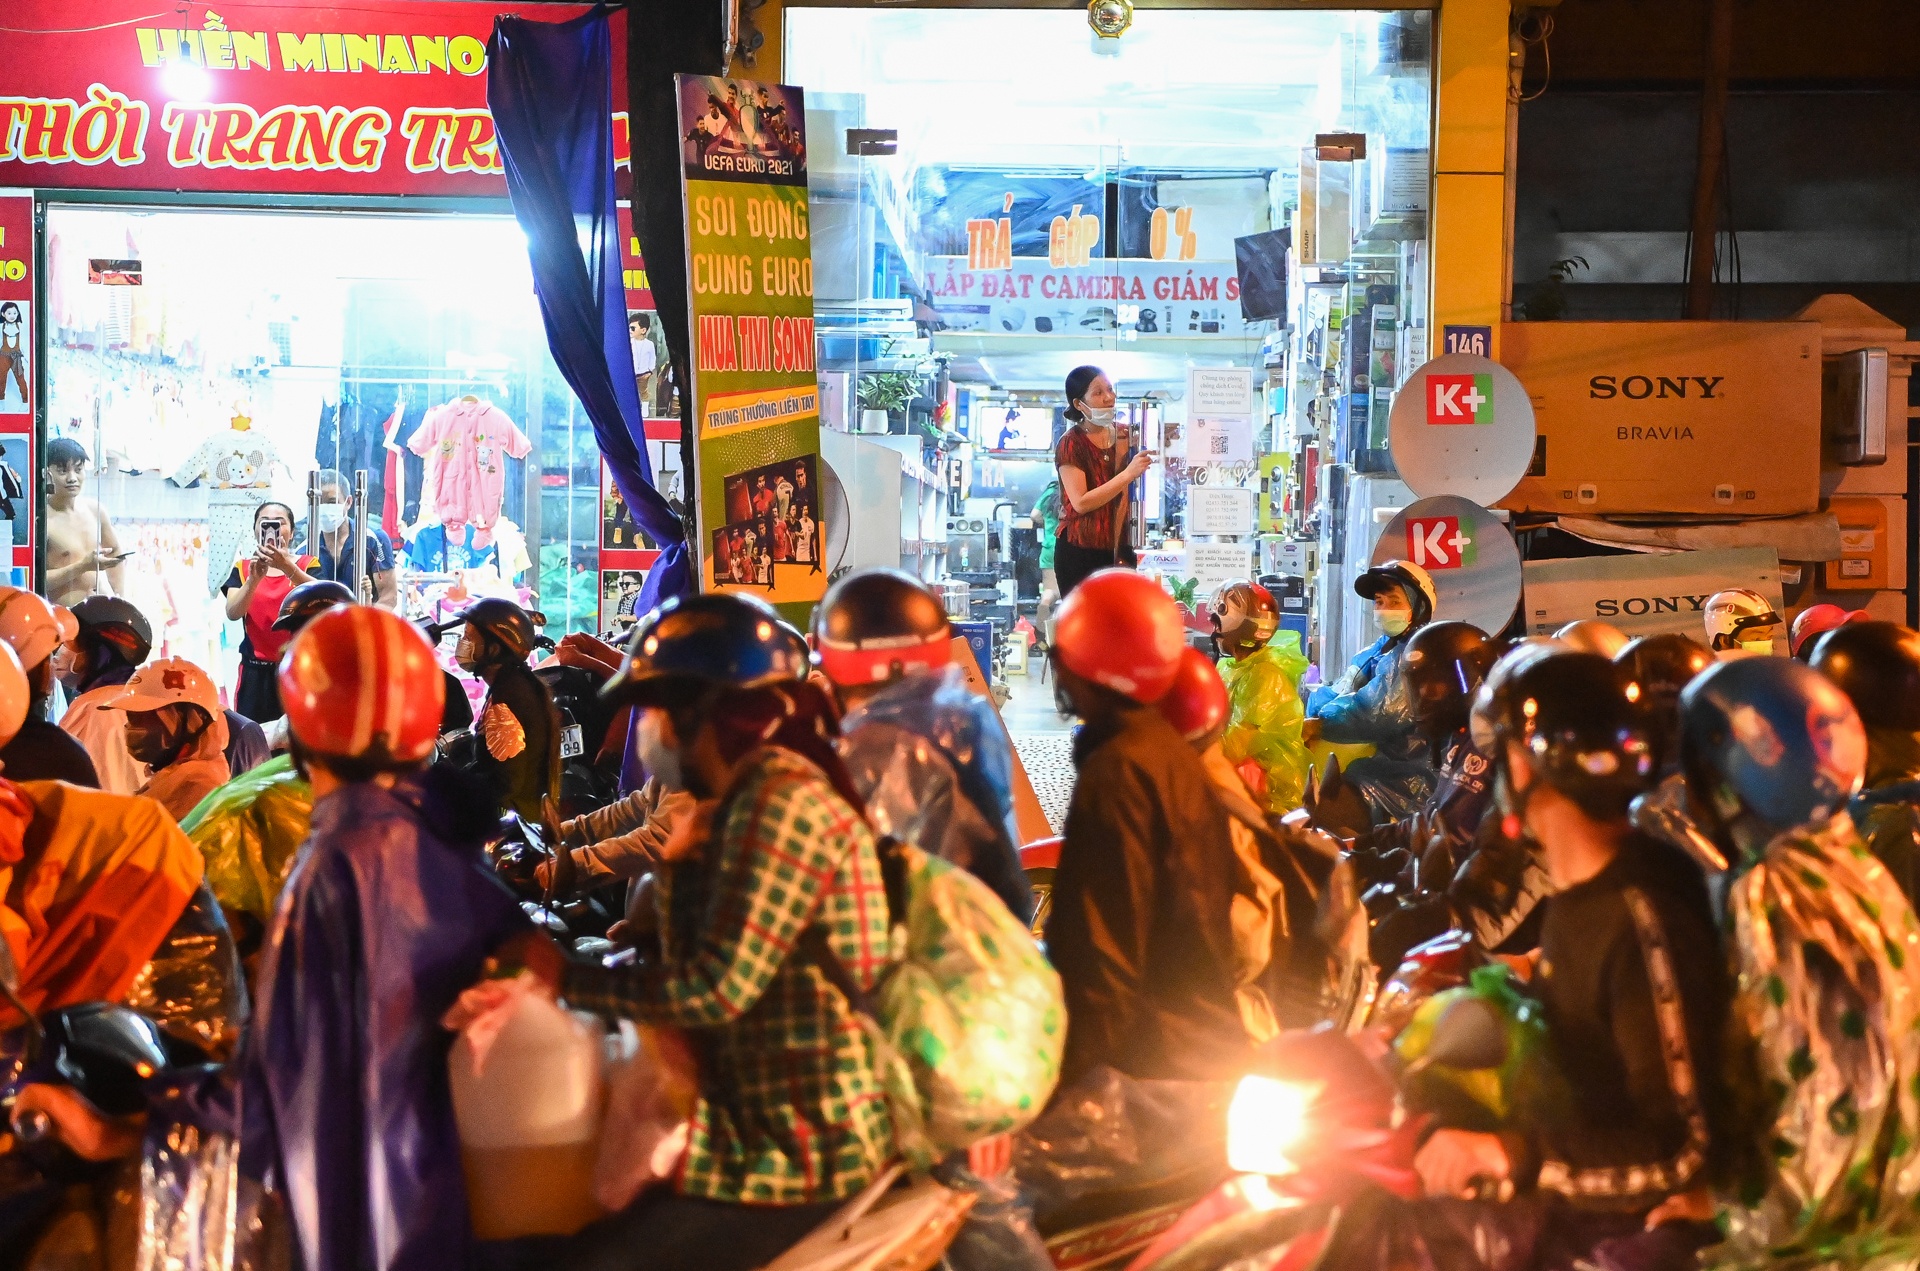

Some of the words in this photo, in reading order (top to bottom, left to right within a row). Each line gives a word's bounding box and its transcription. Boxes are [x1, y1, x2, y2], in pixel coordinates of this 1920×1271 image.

[167, 105, 390, 169] TRANG
[704, 154, 734, 171] UEFA
[737, 157, 765, 173] EURO
[768, 159, 793, 175] 2021
[1050, 204, 1099, 268] GÓP
[763, 256, 813, 297] EURO
[1041, 275, 1146, 300] CAMERA
[1153, 269, 1219, 301] GIÁM
[699, 315, 736, 371] MUA
[738, 315, 770, 372] TIVI
[773, 315, 814, 372] SONY
[1448, 333, 1484, 357] 146
[801, 395, 815, 411] TAY
[1435, 383, 1486, 416] K+
[1590, 375, 1724, 399] SONY
[1617, 426, 1694, 440] BRAVIA
[1413, 521, 1471, 566] K+
[1596, 595, 1709, 616] SONY
